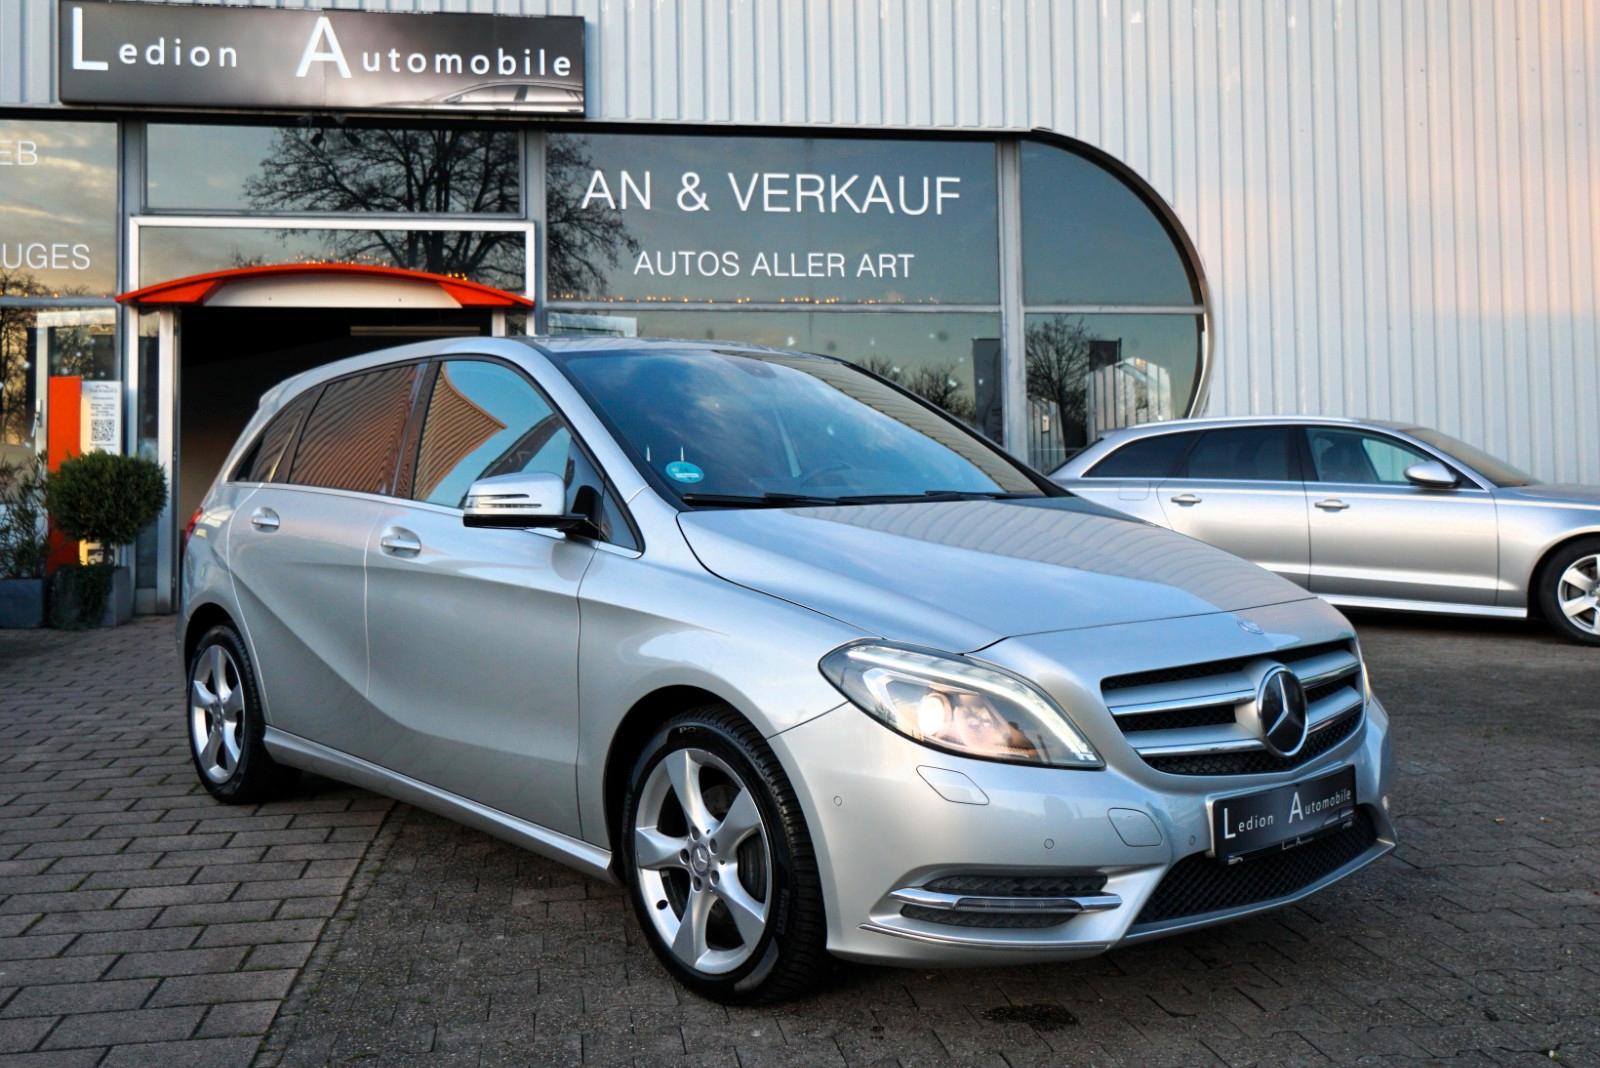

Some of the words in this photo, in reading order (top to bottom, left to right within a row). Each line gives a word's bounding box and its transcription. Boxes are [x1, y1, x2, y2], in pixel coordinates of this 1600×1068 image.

[73, 8, 237, 71] Ledion
[296, 17, 571, 79] Automobile
[581, 169, 651, 211] AN
[676, 172, 710, 212] &
[728, 172, 961, 215] VERKAUF
[2, 243, 91, 270] UGES
[633, 251, 740, 277] AUTOS
[751, 252, 846, 278] ALLER
[856, 254, 915, 278] ART
[1223, 807, 1274, 840] Ledion
[1288, 791, 1351, 824] Automobile
